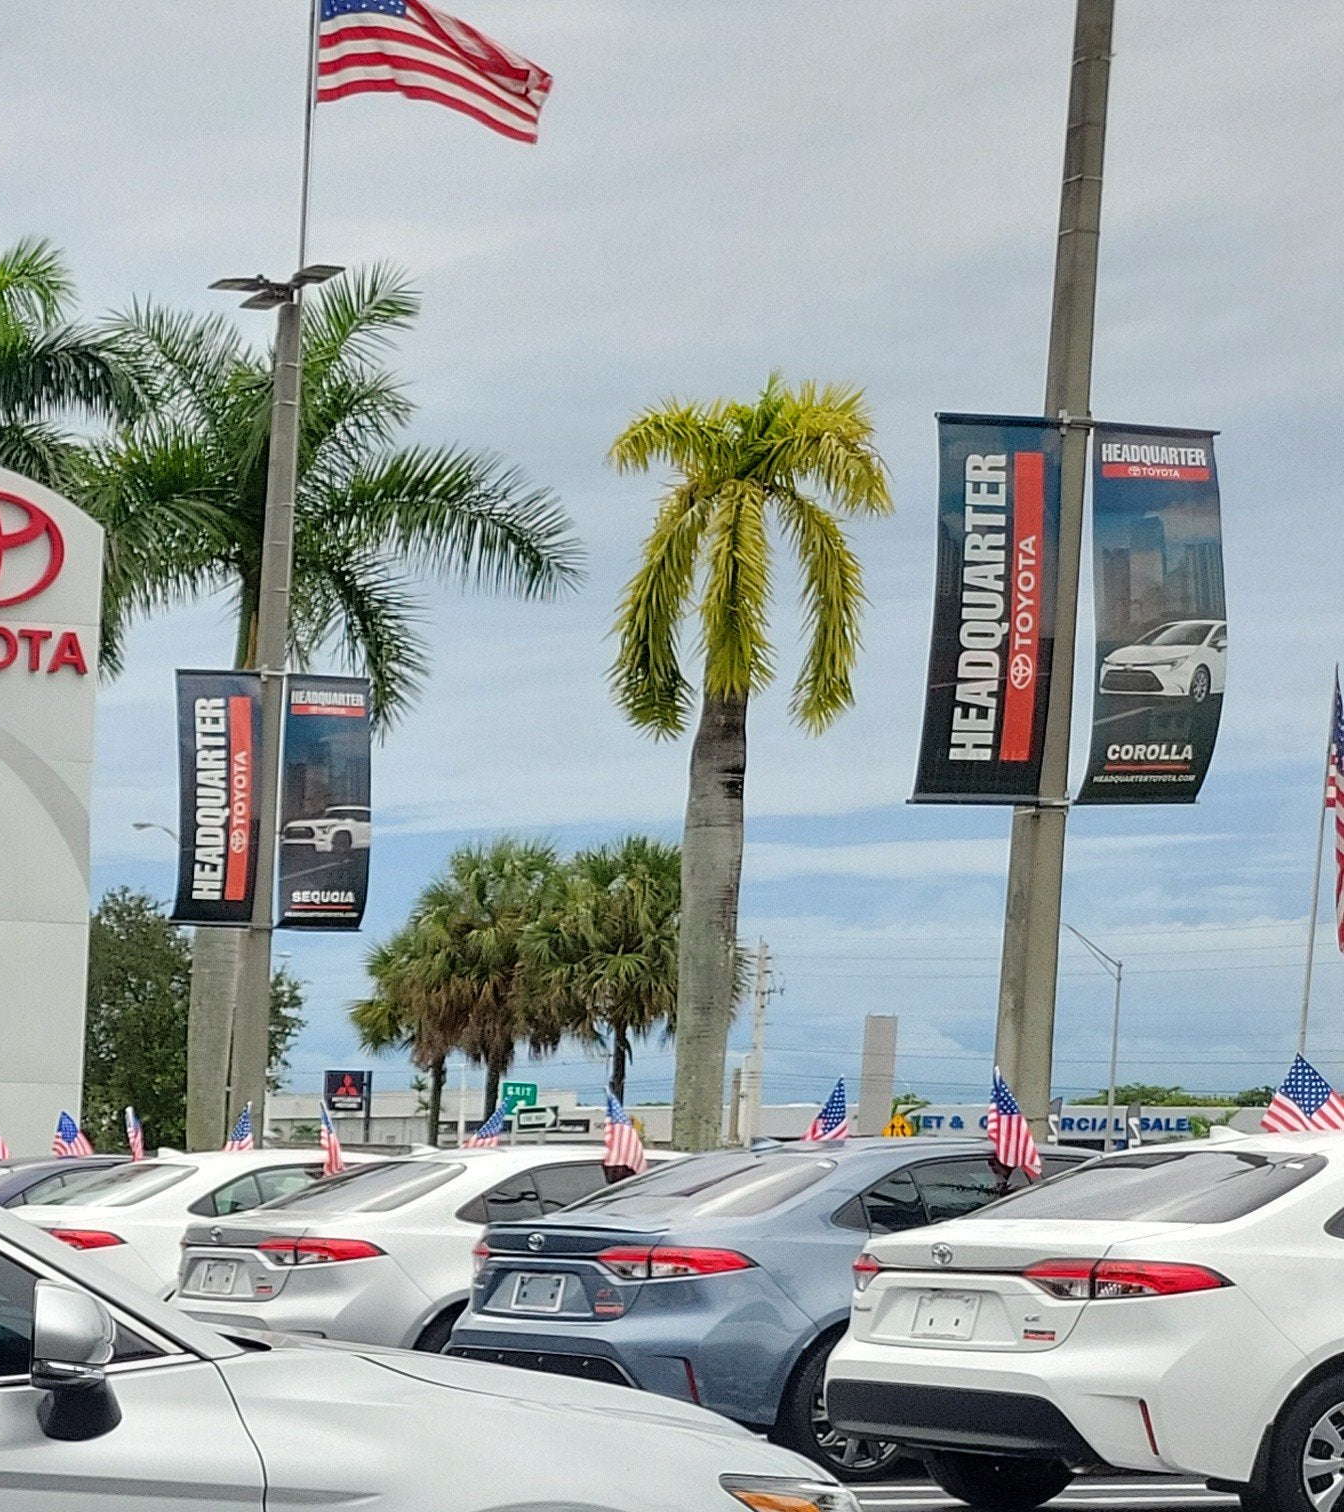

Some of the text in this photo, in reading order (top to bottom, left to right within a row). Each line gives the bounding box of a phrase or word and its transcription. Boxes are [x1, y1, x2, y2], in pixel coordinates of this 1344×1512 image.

[1101, 443, 1207, 467] HEADQUARTER
[1141, 466, 1180, 478] TOYOTA
[1015, 535, 1037, 650] TOYOTA
[948, 453, 1009, 762] HEADQUARTER
[1107, 744, 1193, 760] COROLLA
[232, 750, 248, 827] TOYOTA
[192, 697, 230, 901] HEADQUARTER
[292, 890, 355, 904] SEQUOIA
[507, 1086, 531, 1096] EXIT
[949, 1116, 965, 1129] &
